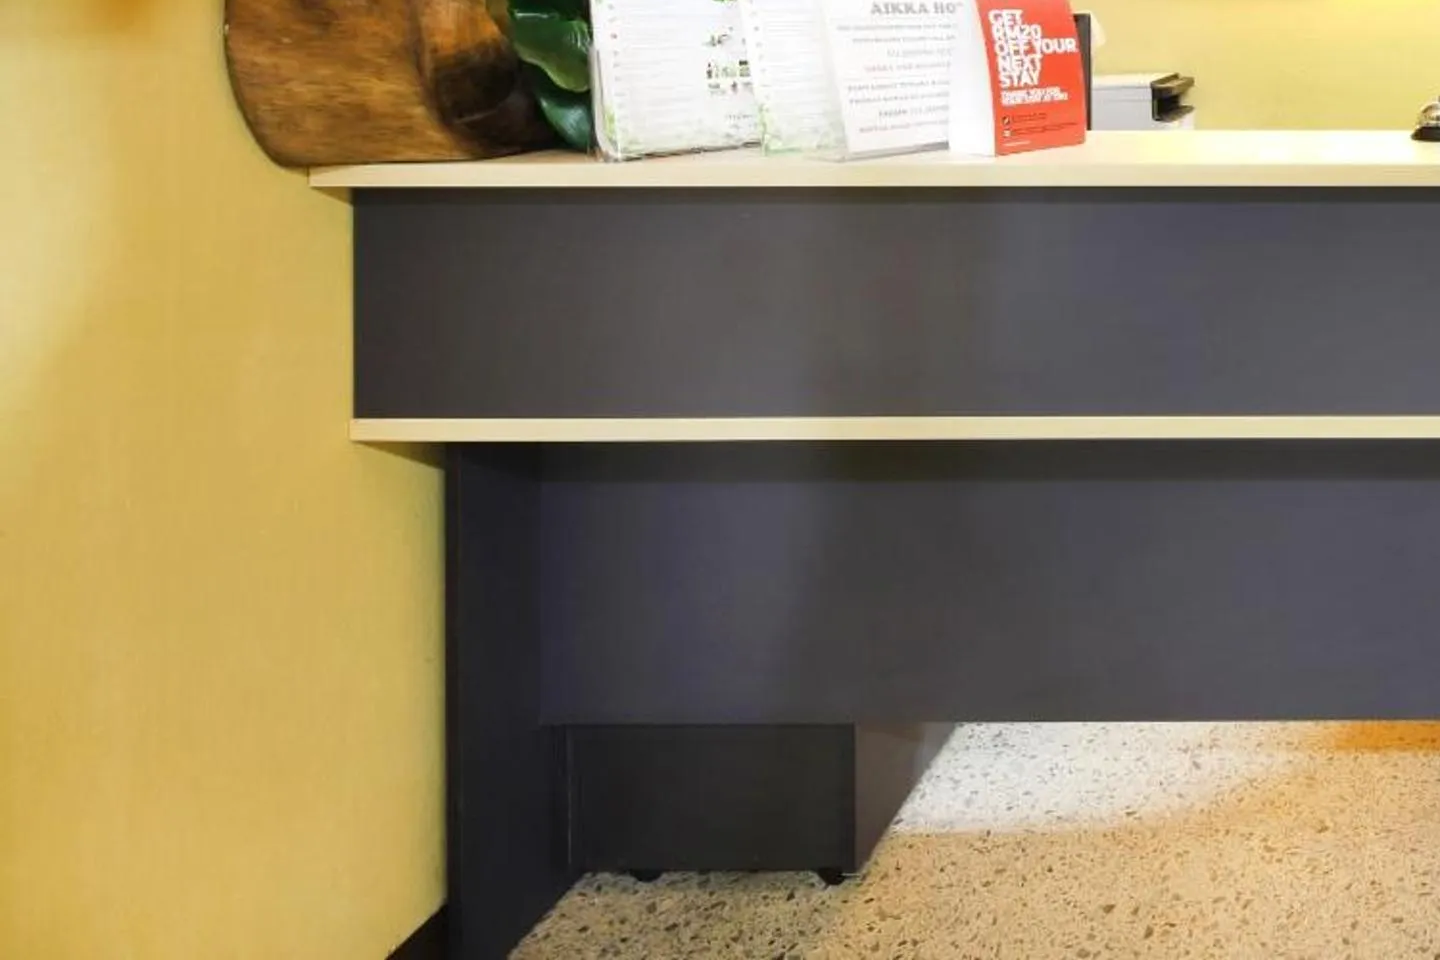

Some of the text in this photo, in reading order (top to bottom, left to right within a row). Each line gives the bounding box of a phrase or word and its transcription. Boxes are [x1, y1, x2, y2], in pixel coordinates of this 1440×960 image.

[933, 1, 963, 15] HO
[988, 9, 1023, 25] GET
[991, 24, 1042, 41] RM20
[995, 37, 1078, 56] OFF YOUR
[997, 55, 1043, 73] NEXT
[999, 71, 1041, 88] STAY
